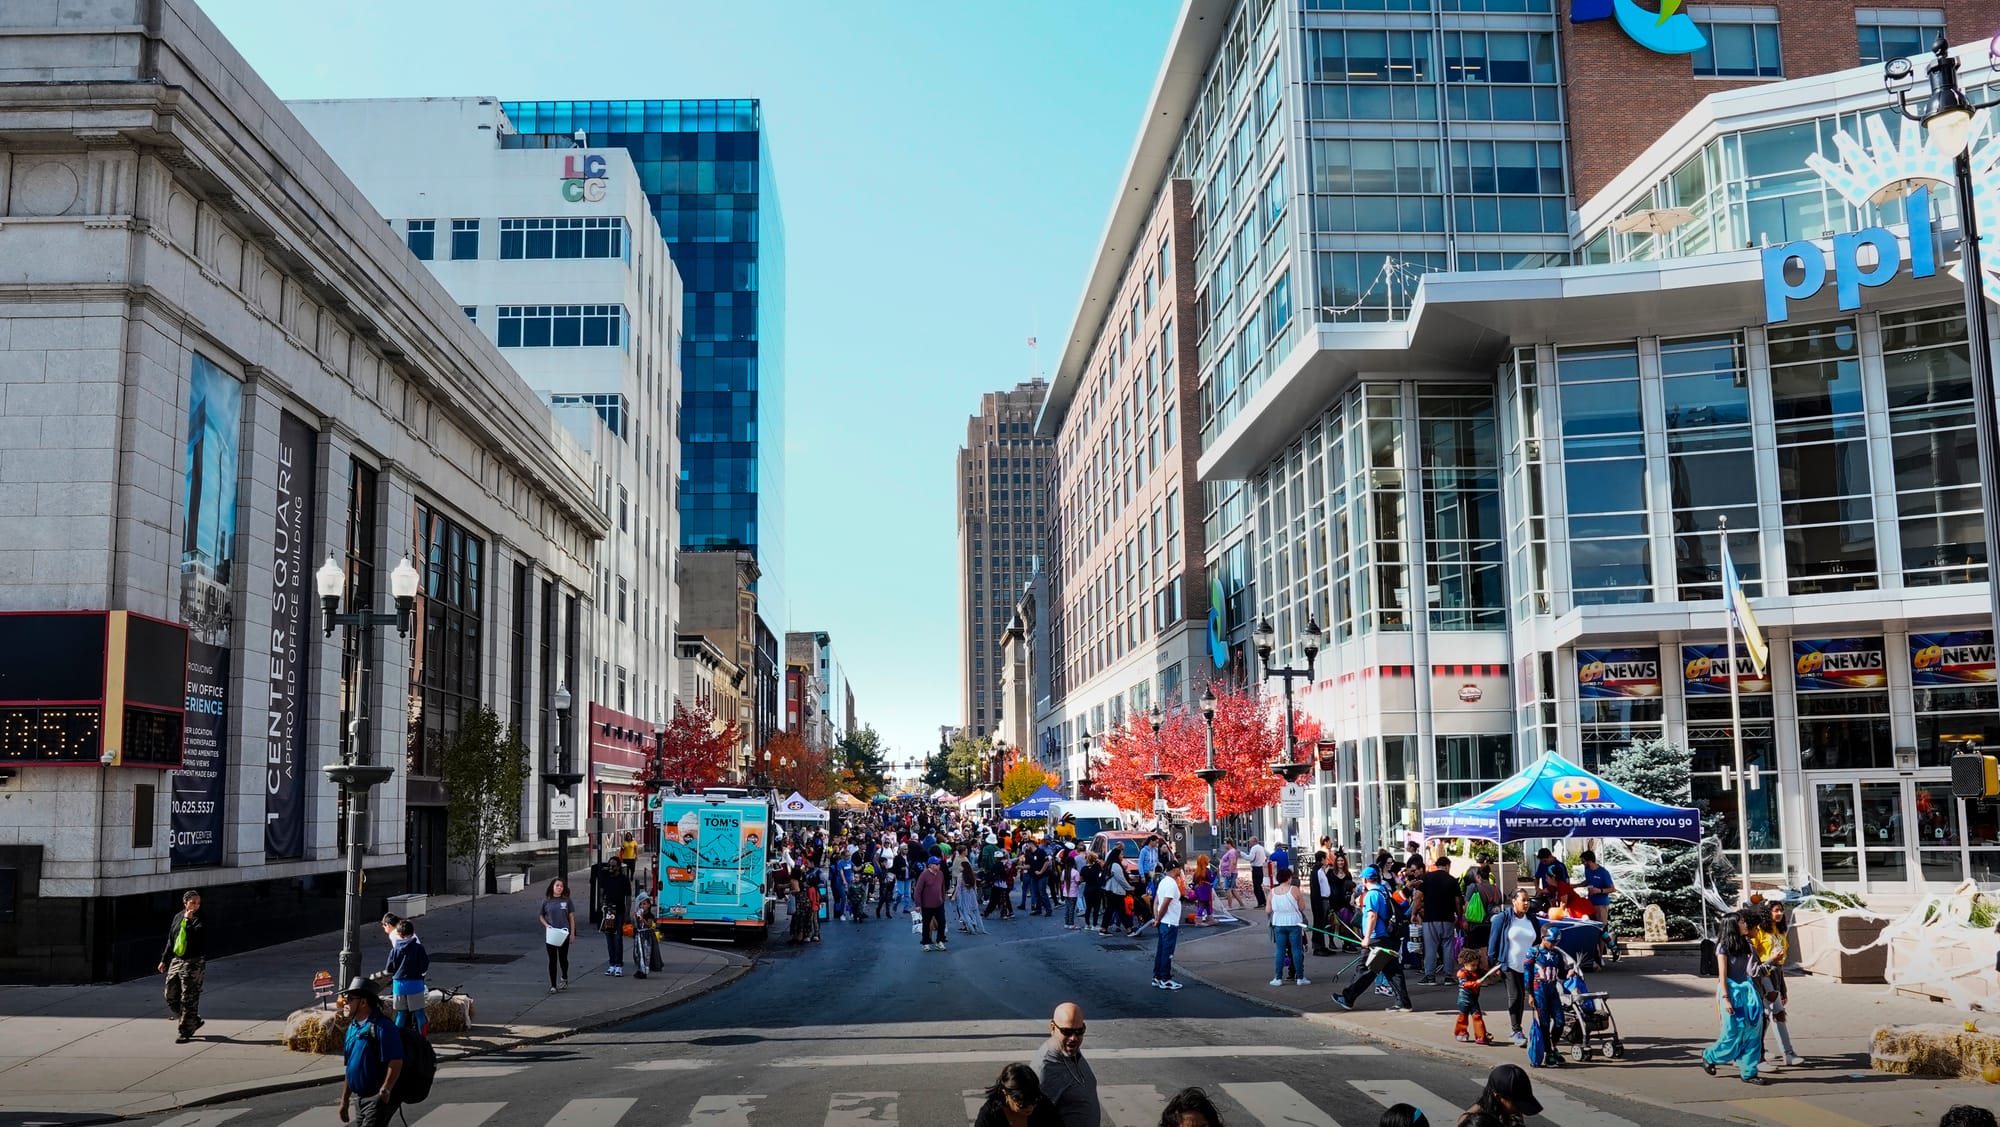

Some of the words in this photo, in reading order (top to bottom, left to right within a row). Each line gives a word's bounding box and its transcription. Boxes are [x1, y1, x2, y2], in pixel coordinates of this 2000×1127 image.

[1761, 184, 1936, 324] ppl
[273, 442, 292, 614] SQUARE
[292, 496, 303, 586] BUILDING
[288, 593, 299, 663] OFFICE
[1685, 657, 1712, 679] 69
[1797, 651, 1823, 674] 69
[1824, 652, 1881, 669] NEWS
[1914, 645, 1942, 669] 69
[1579, 661, 1604, 683] 69
[1604, 662, 1656, 678] NEWS
[199, 684, 224, 698] OFFICE
[267, 628, 285, 794] CENTER
[192, 728, 213, 736] LOCATION
[285, 670, 297, 779] APPROVED
[189, 738, 217, 747] WORKSPACES
[197, 749, 220, 758] AMENITIES
[196, 760, 210, 768] VIEWS
[1552, 776, 1599, 804] 69
[171, 801, 215, 813] 10.625.5537
[268, 812, 280, 825] 1
[704, 817, 740, 828] TOM'S
[1505, 817, 1587, 828] WFMZ.COM
[1592, 815, 1655, 827] everywhere
[1656, 818, 1676, 830] you
[1678, 819, 1693, 830] go
[178, 831, 196, 846] CITY
